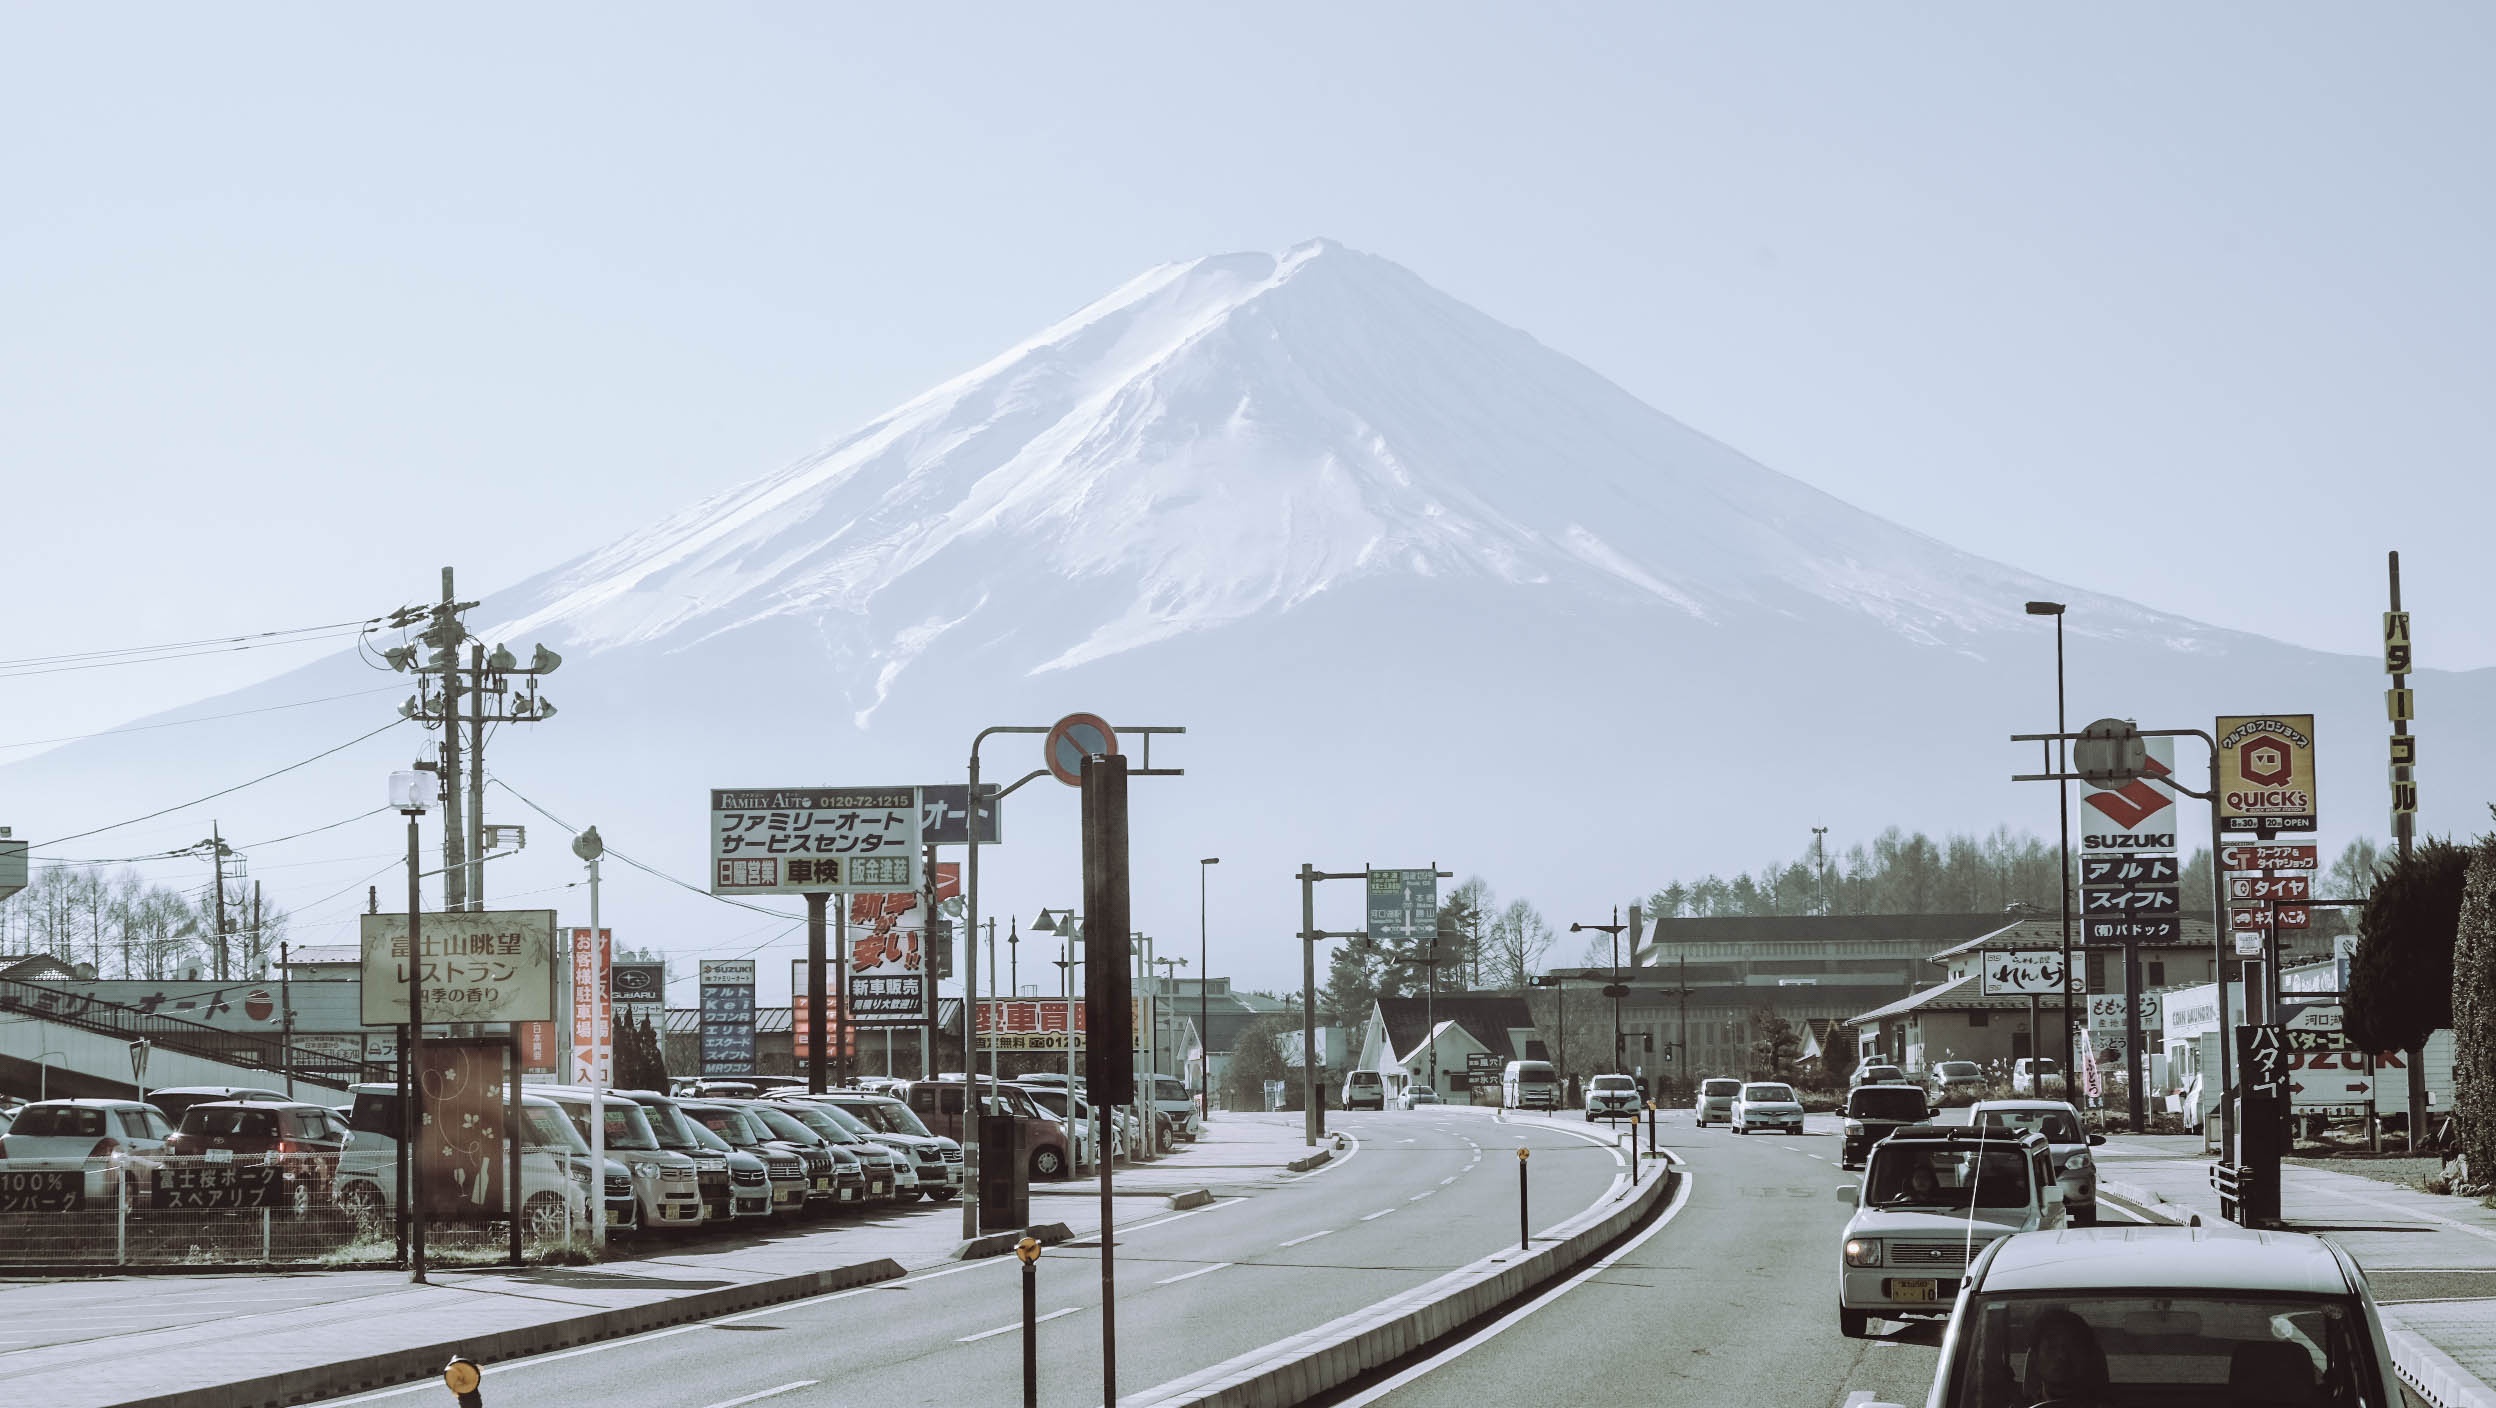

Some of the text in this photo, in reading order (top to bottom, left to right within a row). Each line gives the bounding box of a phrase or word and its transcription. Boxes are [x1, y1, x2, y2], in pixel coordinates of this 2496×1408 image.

[2386, 613, 2416, 812] パターゴル
[721, 791, 909, 809] FAMILY AUTO 0120-72-1215
[2226, 791, 2308, 811] QUICK's
[721, 811, 905, 832] ファミリーオート
[2284, 818, 2309, 826] OPEN
[721, 833, 906, 853] サービスセンター
[2084, 834, 2175, 848] SUZUKI
[720, 858, 909, 885] 日曜営業 車検 鈑金塗装
[2088, 861, 2173, 880] アルト
[2257, 857, 2314, 868] タイヤショップ
[2255, 880, 2305, 896] タイヤ
[2088, 891, 2173, 909] スイフト
[2278, 910, 2306, 924] へこみ
[391, 933, 522, 958] 富士山眺望
[397, 961, 518, 984] レストラン
[575, 934, 592, 1038] お客様駐車場
[704, 987, 750, 998] アルト
[852, 978, 919, 997] 新車販売
[705, 1000, 750, 1010] Kei
[704, 1012, 751, 1022] ワゴンR
[705, 1025, 751, 1035] エリオ
[704, 1037, 751, 1047] エスクード
[705, 1050, 751, 1060] スイフト
[704, 1063, 751, 1074] MRワゴン
[1, 1174, 63, 1192] 100%
[160, 1168, 275, 1190] 富士桜ポーク
[168, 1188, 267, 1209] スペアリブ
